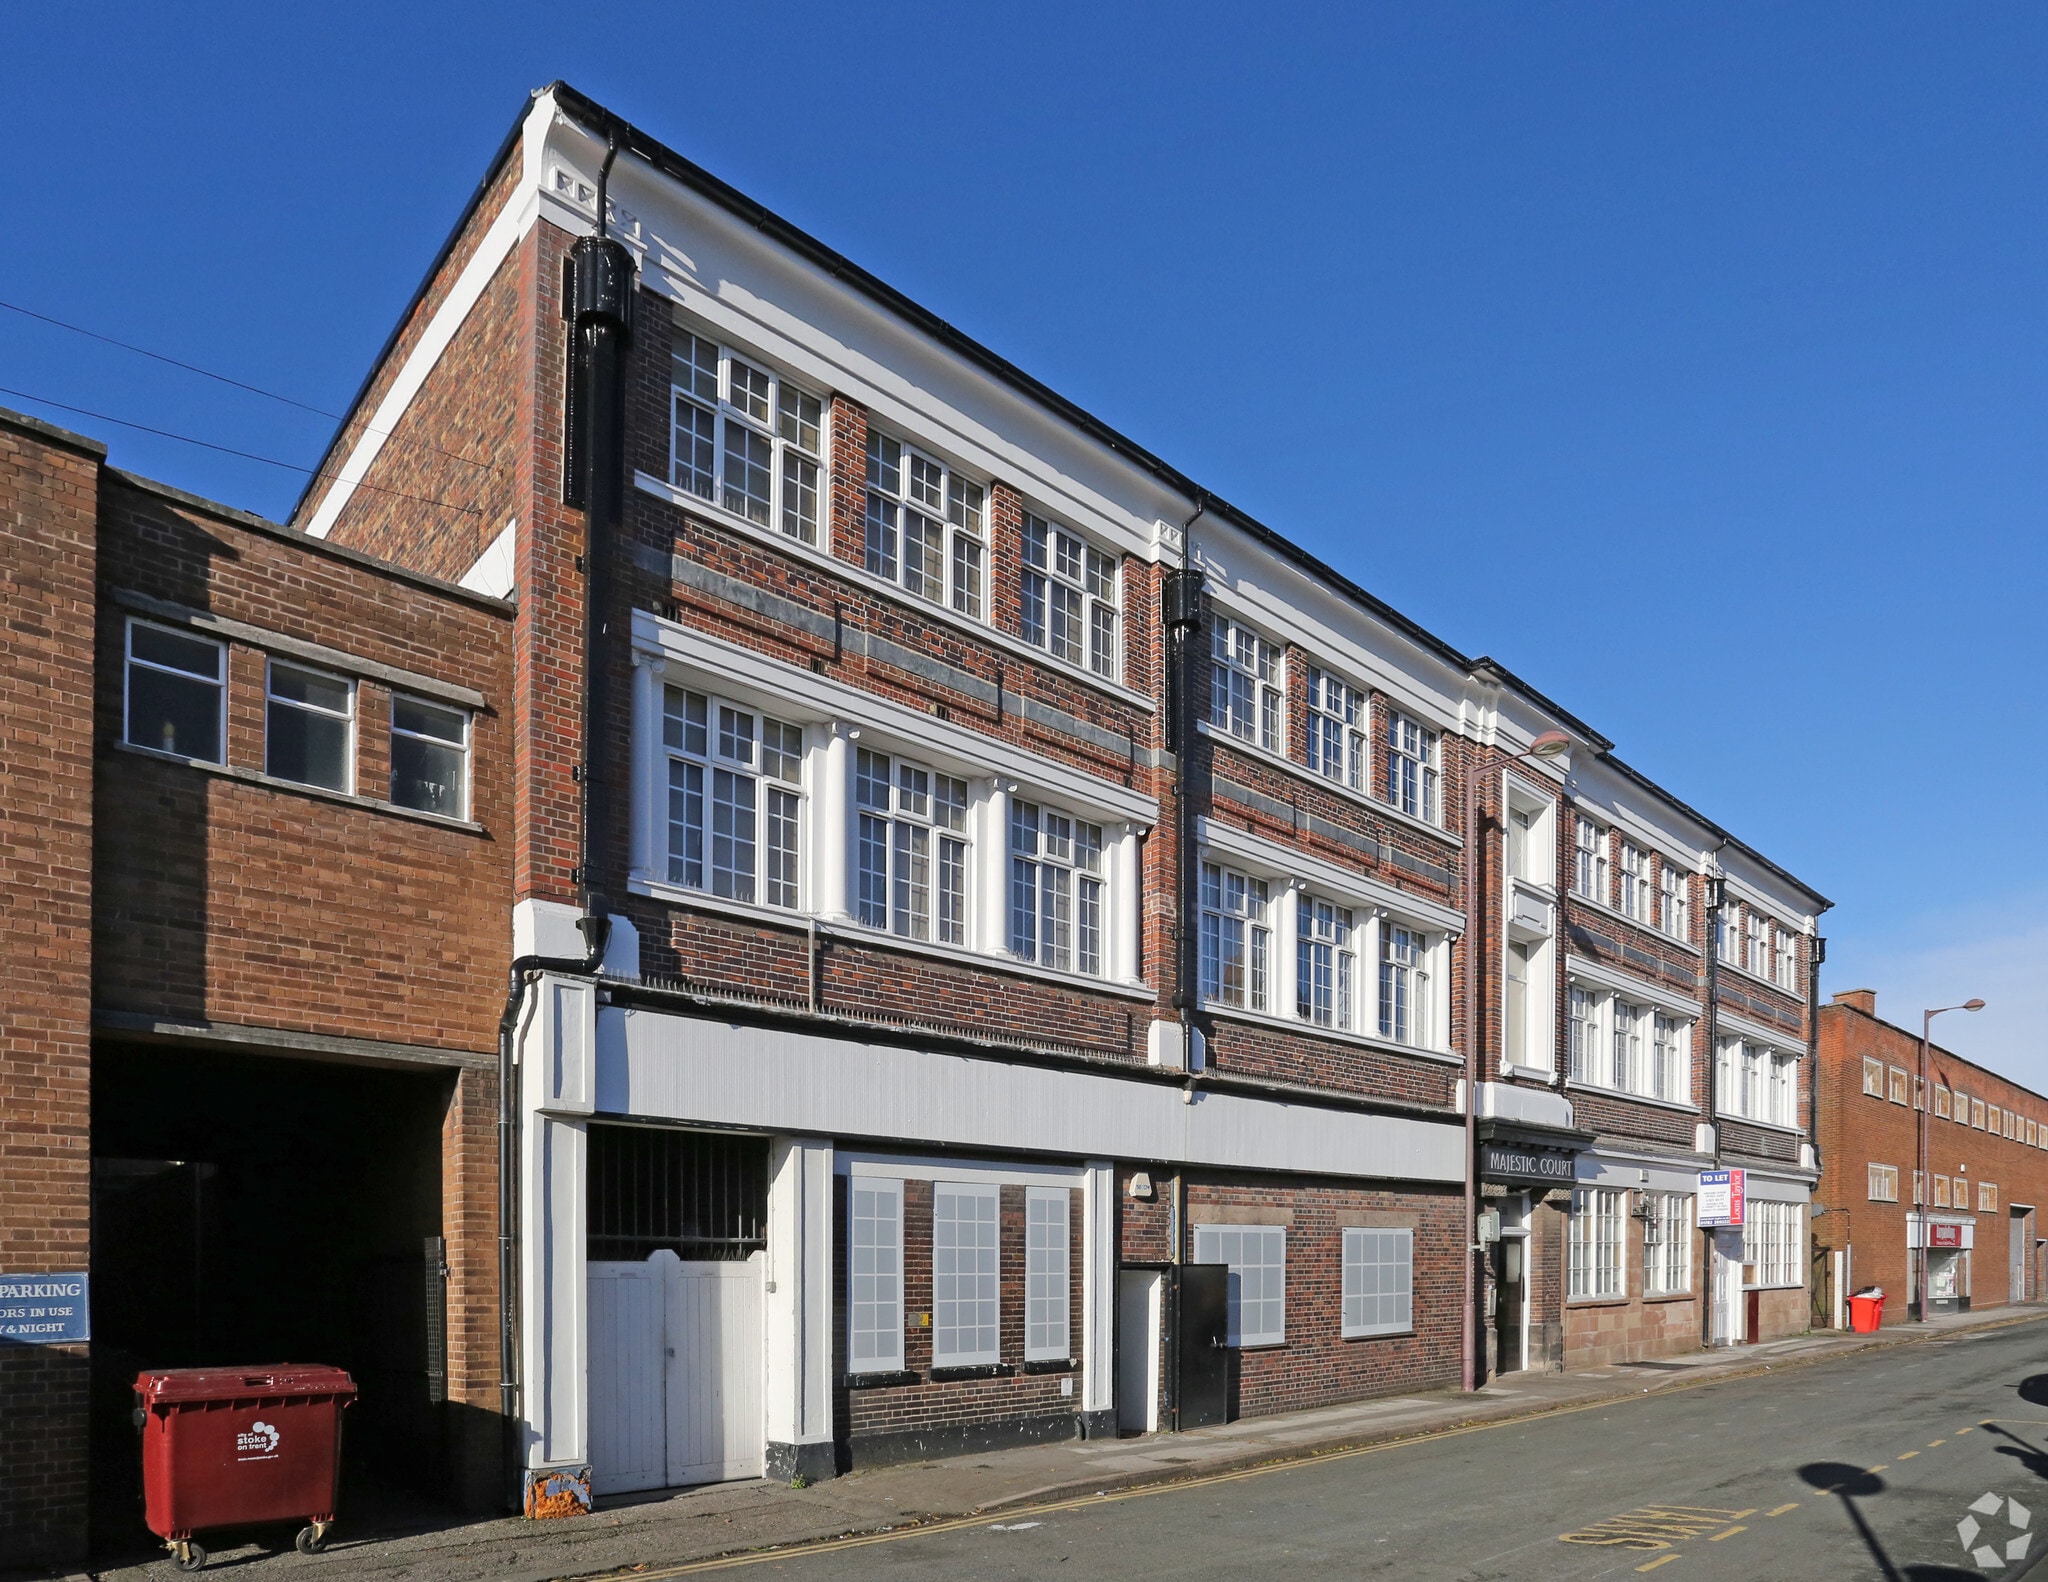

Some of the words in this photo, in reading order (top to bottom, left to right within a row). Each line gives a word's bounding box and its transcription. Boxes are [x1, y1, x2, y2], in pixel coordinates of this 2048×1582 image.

[1490, 1152, 1536, 1173] MAJESTIC
[1540, 1158, 1572, 1177] COURT
[1715, 1174, 1729, 1182] LET
[1731, 1175, 1744, 1199] Taylor
[1731, 1199, 1741, 1220] Louis
[0, 1283, 82, 1299] PARKING
[30, 1308, 47, 1318] IN
[49, 1307, 73, 1317] USE
[6, 1324, 17, 1334] &
[19, 1323, 66, 1334] NIGHT
[237, 1435, 267, 1445] stoke
[249, 1442, 267, 1450] trent
[1558, 1504, 1758, 1551] TAXIS
